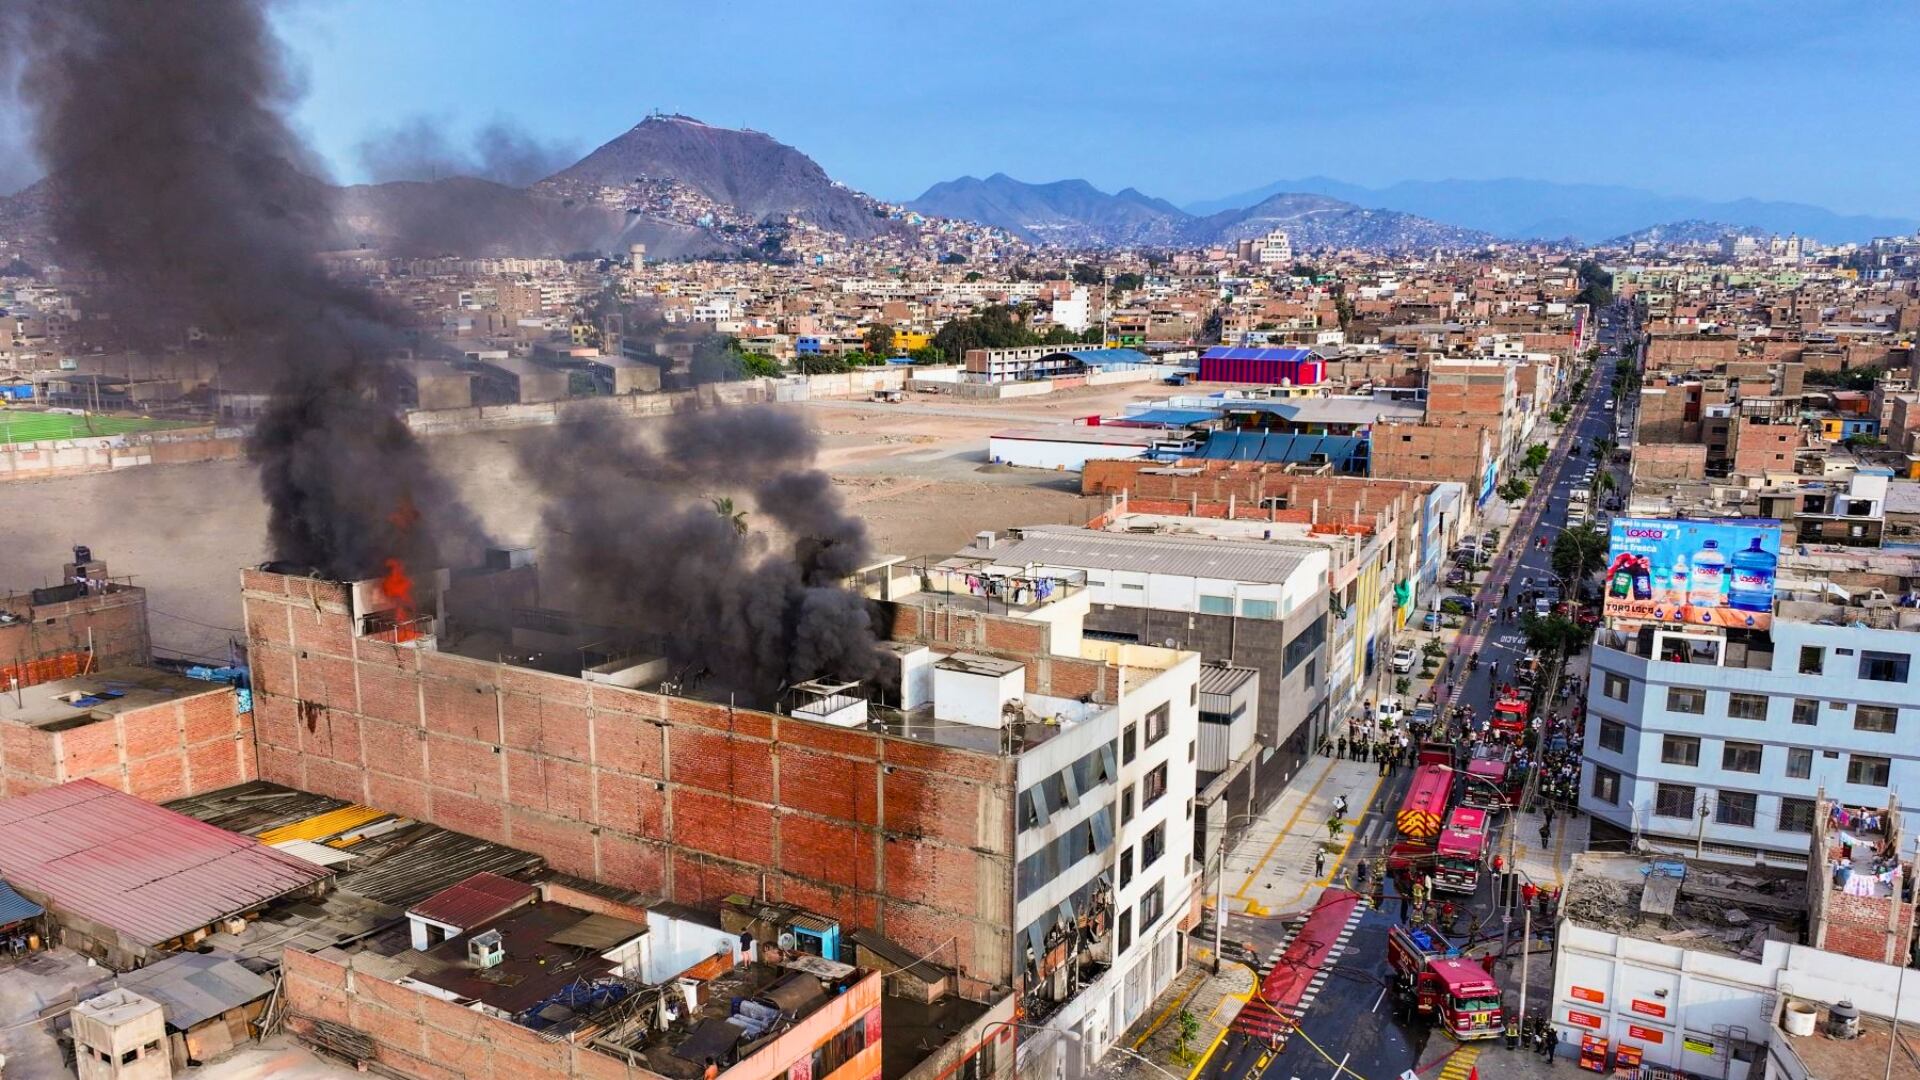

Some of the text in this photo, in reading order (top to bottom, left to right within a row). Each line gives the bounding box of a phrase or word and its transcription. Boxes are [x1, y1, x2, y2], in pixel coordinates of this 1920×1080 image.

[1606, 603, 1630, 612] TORO
[1631, 606, 1654, 614] LOCO
[1475, 1013, 1488, 1023] 10
